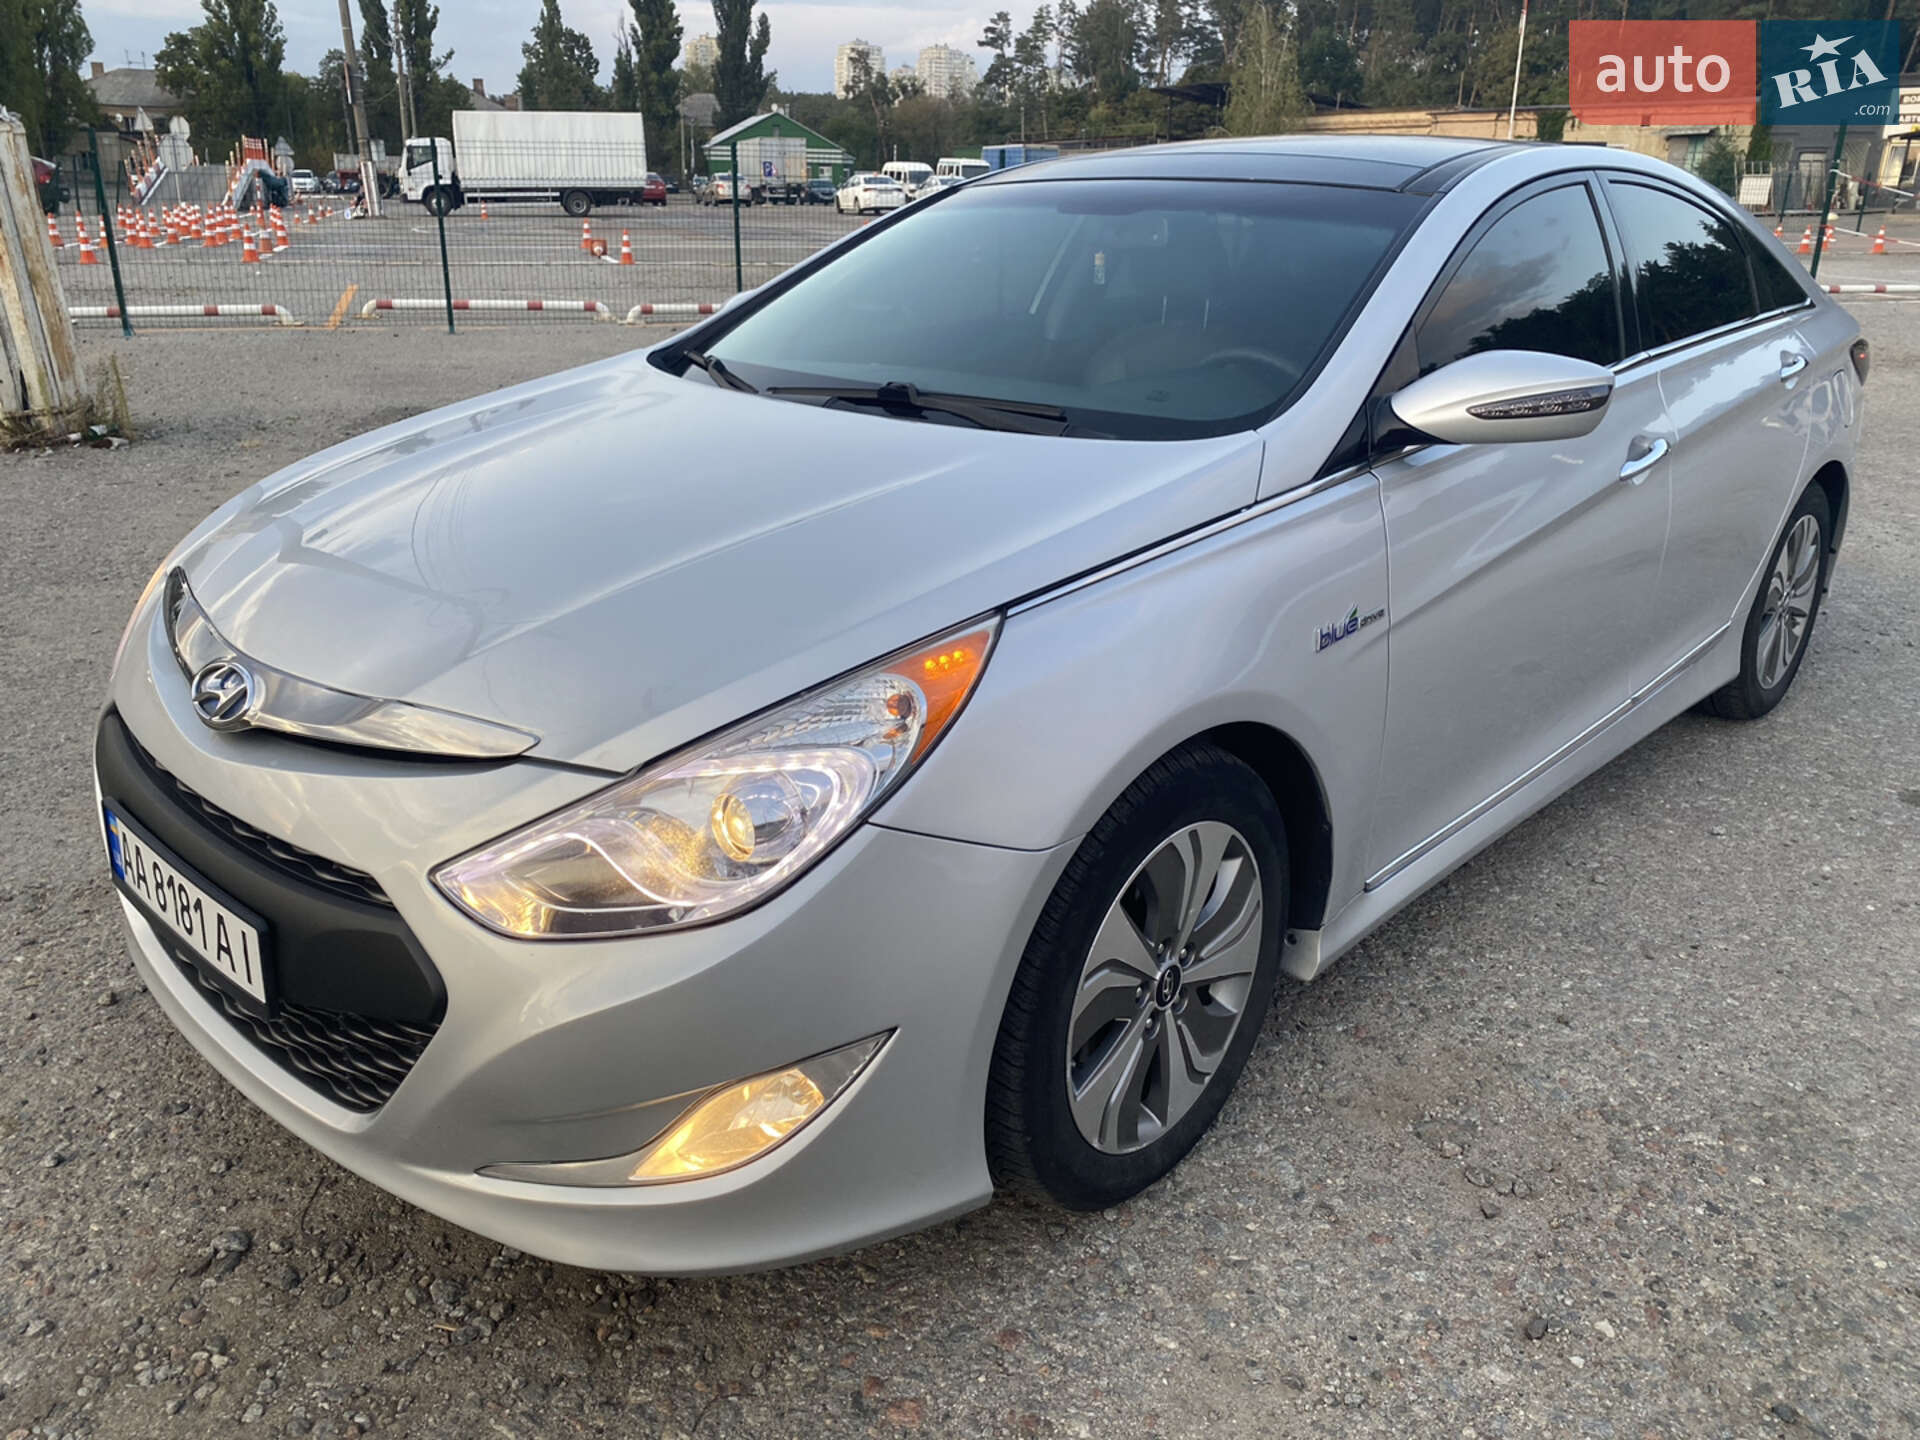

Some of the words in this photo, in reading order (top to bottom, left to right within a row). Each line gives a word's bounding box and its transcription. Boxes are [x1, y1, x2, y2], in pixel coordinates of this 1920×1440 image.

[1315, 616, 1359, 653] blue
[121, 831, 151, 899] AA
[152, 861, 208, 950] 8181
[216, 912, 252, 985] AI
